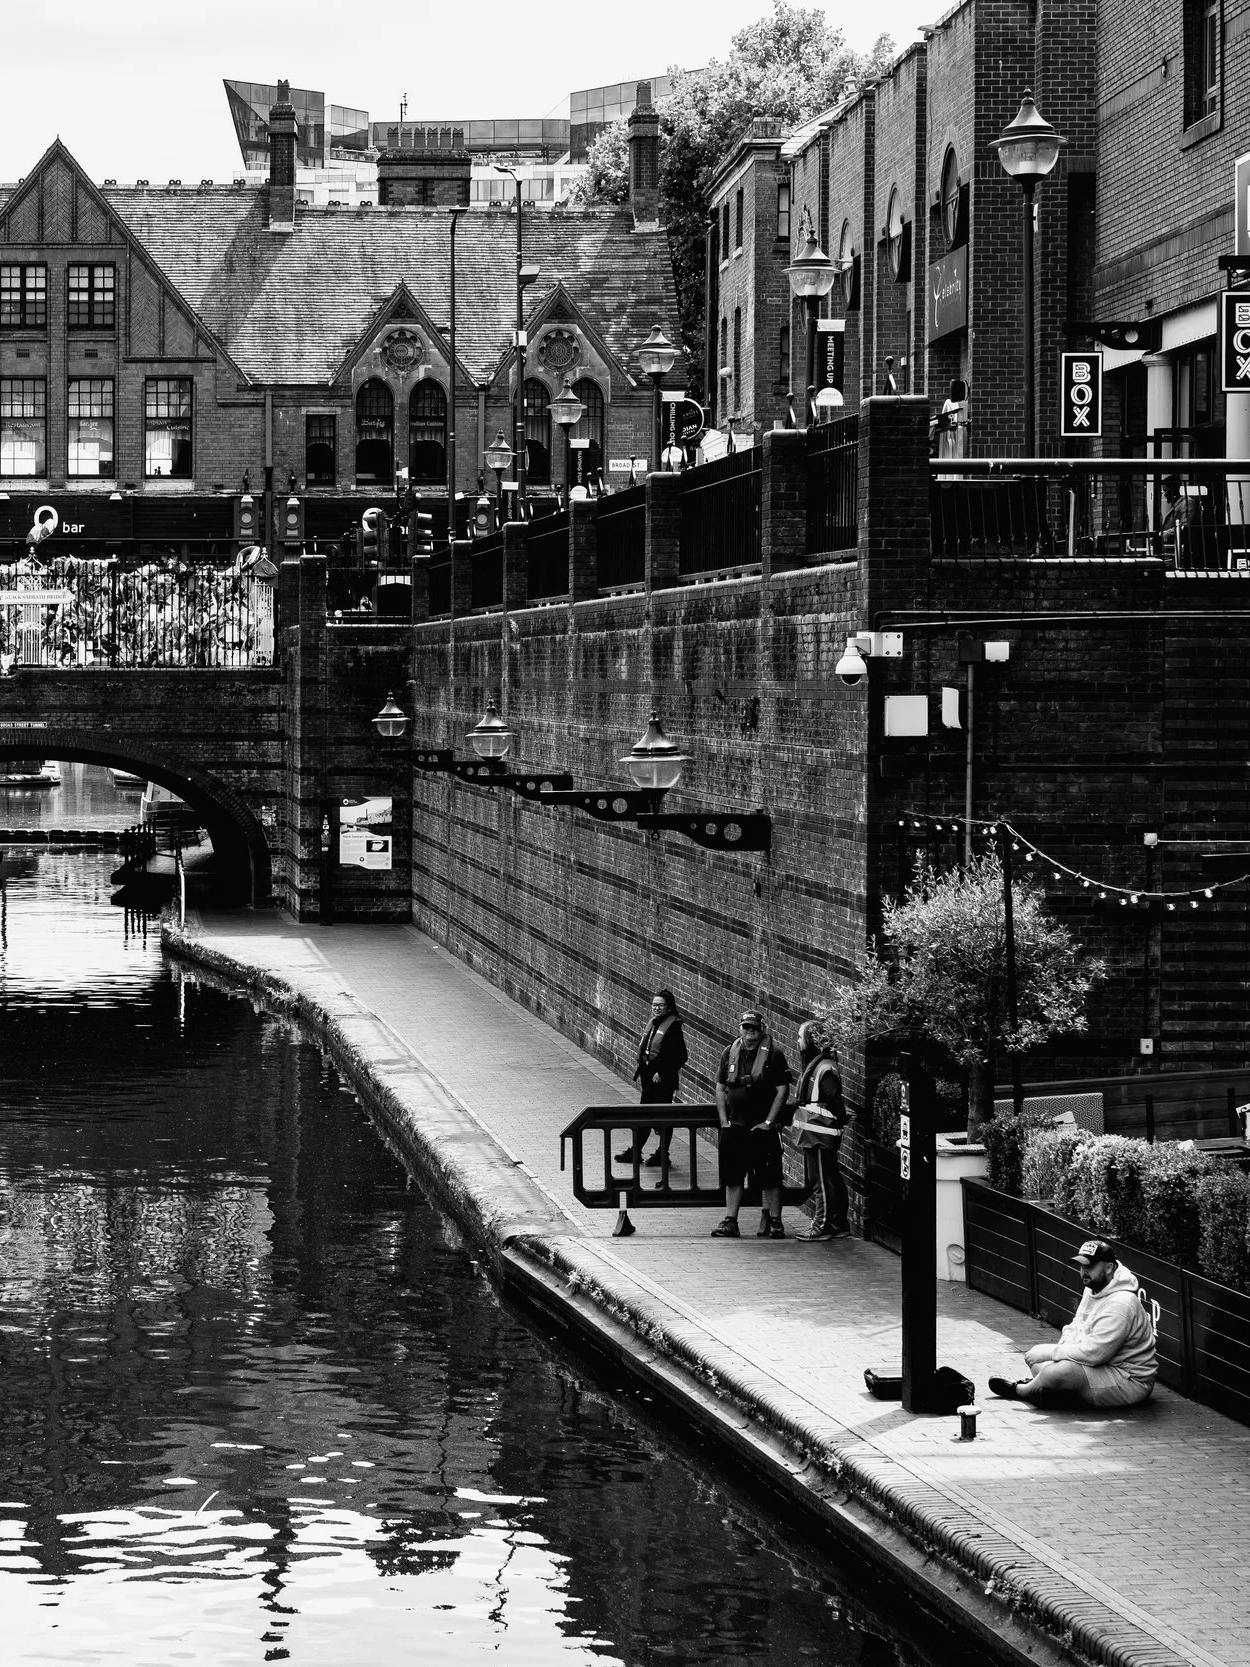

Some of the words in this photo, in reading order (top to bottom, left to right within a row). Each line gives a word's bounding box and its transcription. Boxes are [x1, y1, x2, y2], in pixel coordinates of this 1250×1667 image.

[826, 335, 835, 371] MEETING
[826, 373, 834, 384] UP
[1070, 361, 1093, 427] BOX
[62, 521, 85, 533] bar
